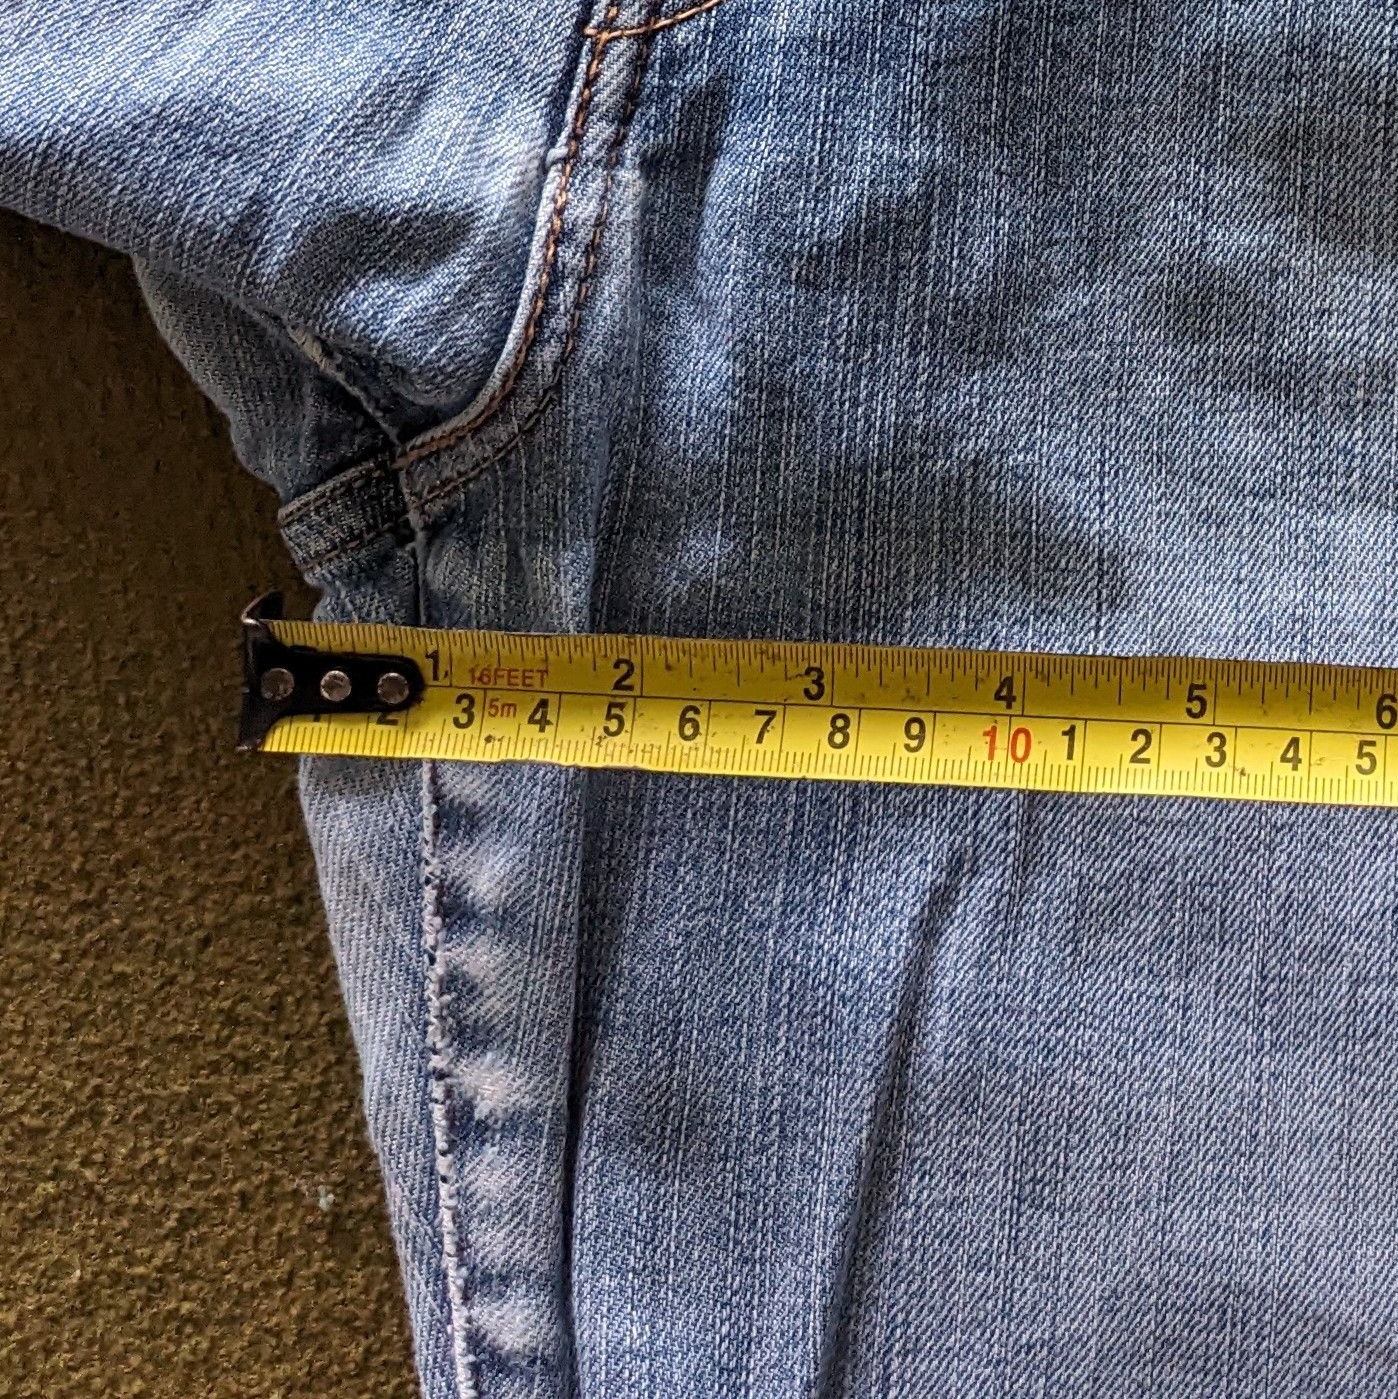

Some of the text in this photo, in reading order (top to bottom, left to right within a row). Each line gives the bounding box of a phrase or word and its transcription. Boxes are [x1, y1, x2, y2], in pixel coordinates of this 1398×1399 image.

[613, 658, 636, 692] 2
[803, 666, 826, 701] 3
[993, 675, 1017, 710] 4
[1185, 683, 1208, 719] 5
[1375, 693, 1398, 729] 6
[452, 693, 476, 729] 3
[527, 698, 553, 733] 4
[602, 701, 626, 738] 5
[677, 705, 701, 742] 6
[753, 709, 778, 745] 7
[827, 712, 851, 749] 8
[903, 716, 927, 753] 9
[982, 725, 1033, 764] 10
[1060, 724, 1077, 761] 1
[1130, 728, 1153, 764] 2
[1205, 732, 1228, 768] 3
[1279, 736, 1303, 772] 4
[1355, 739, 1378, 776] 5
